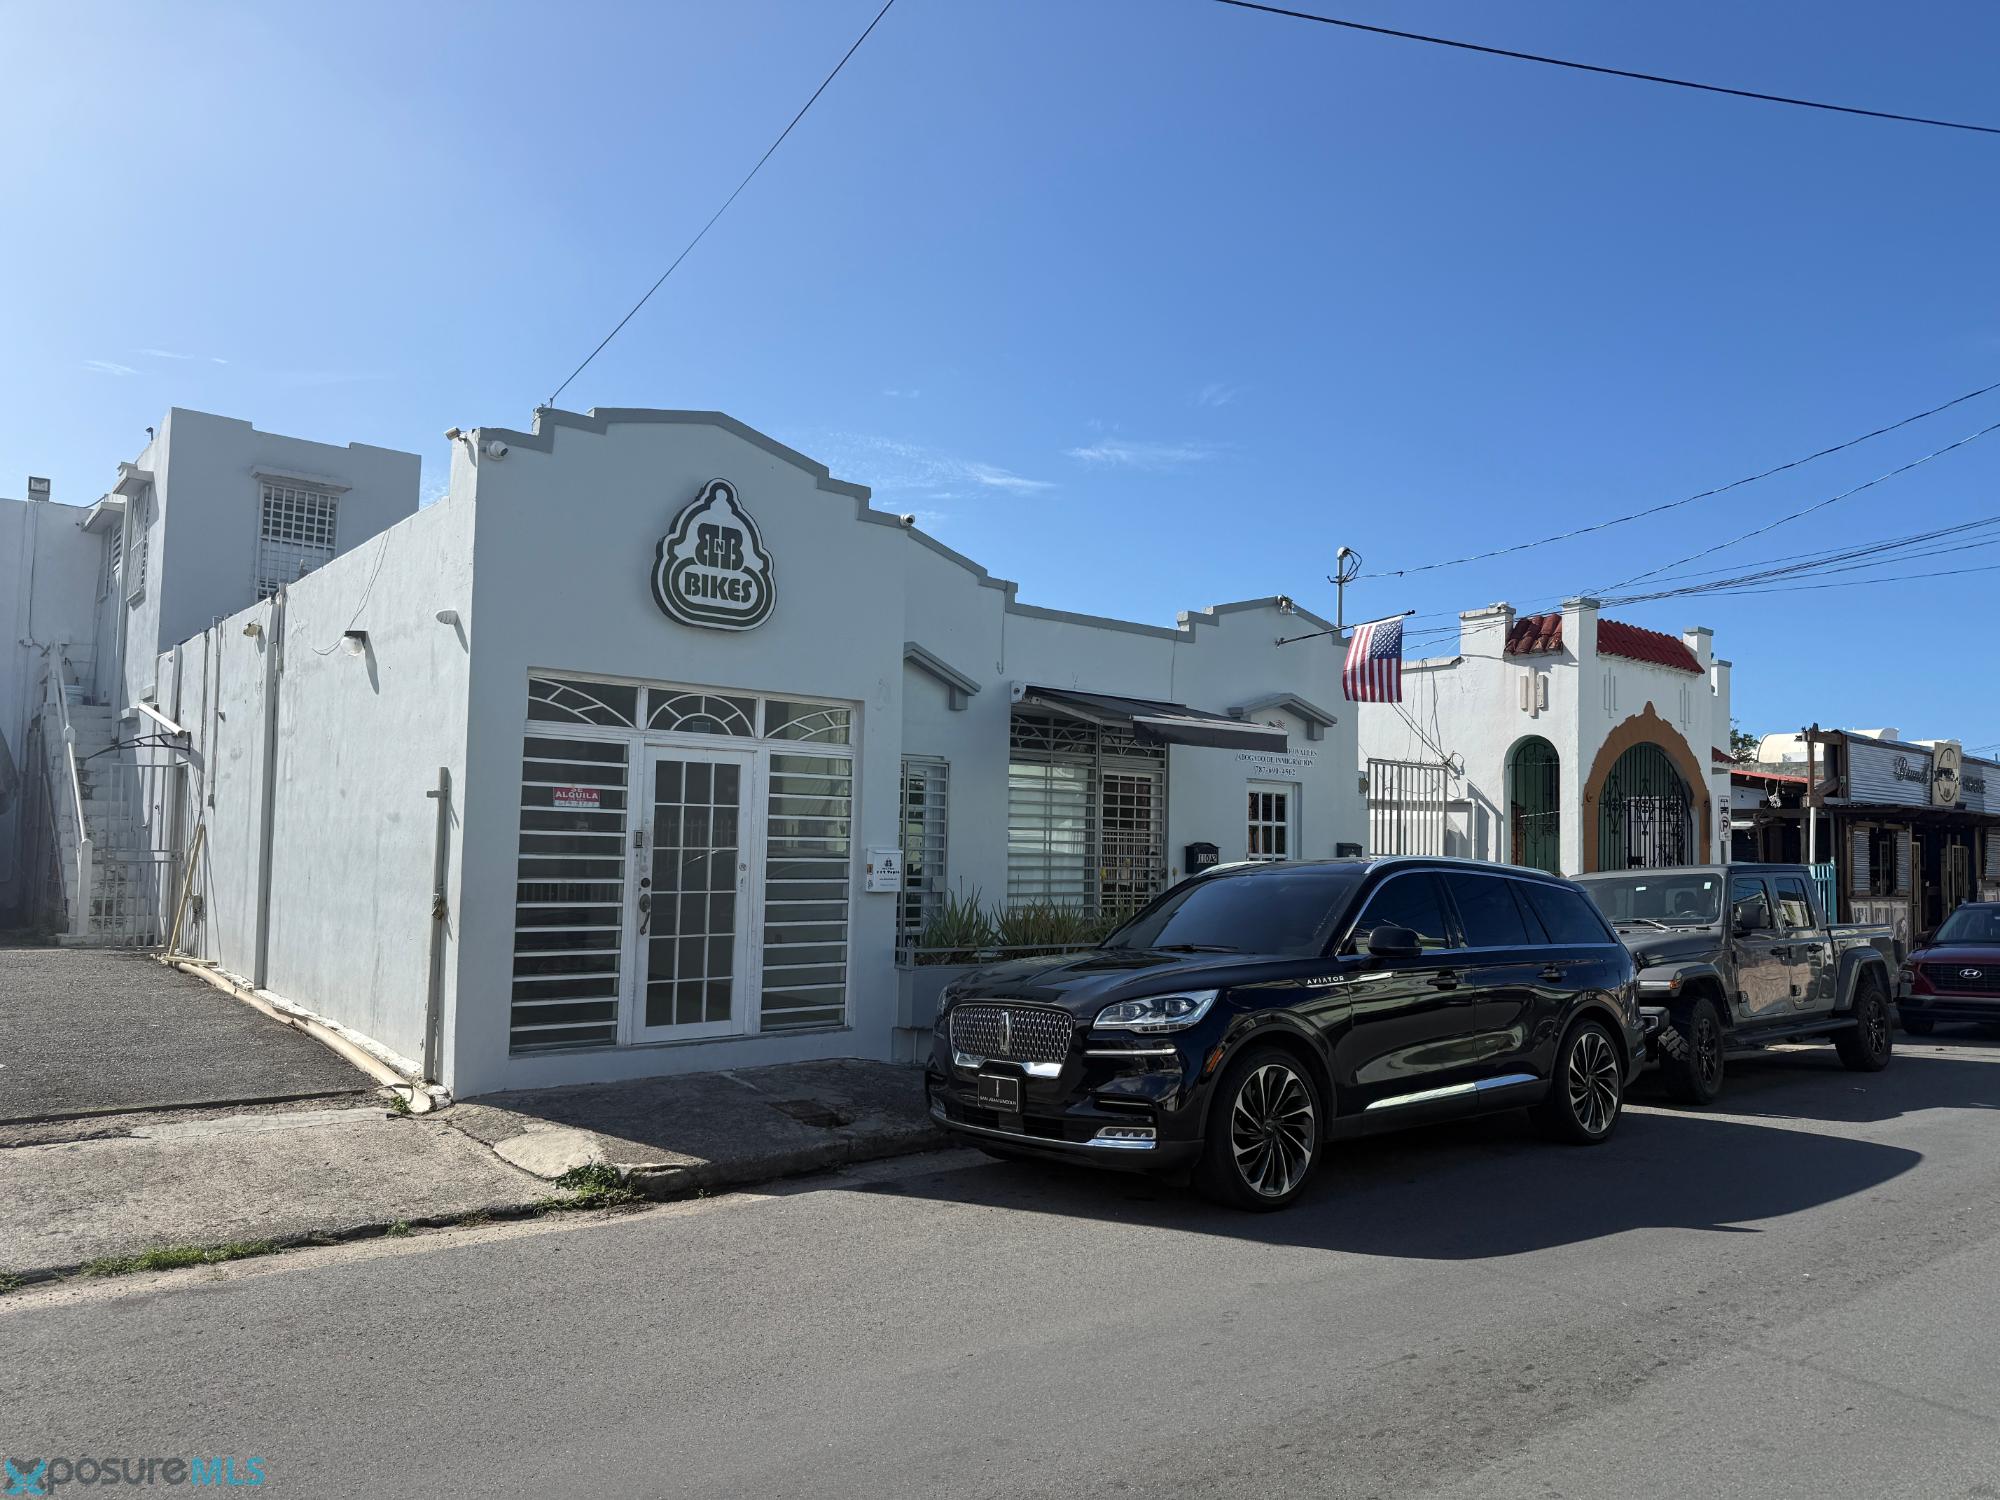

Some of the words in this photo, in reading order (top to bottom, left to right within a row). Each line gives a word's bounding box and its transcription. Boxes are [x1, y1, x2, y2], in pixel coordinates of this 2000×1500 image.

[684, 571, 752, 603] BIKES
[555, 790, 599, 799] ALQUILA
[1307, 975, 1345, 985] AVIATOR
